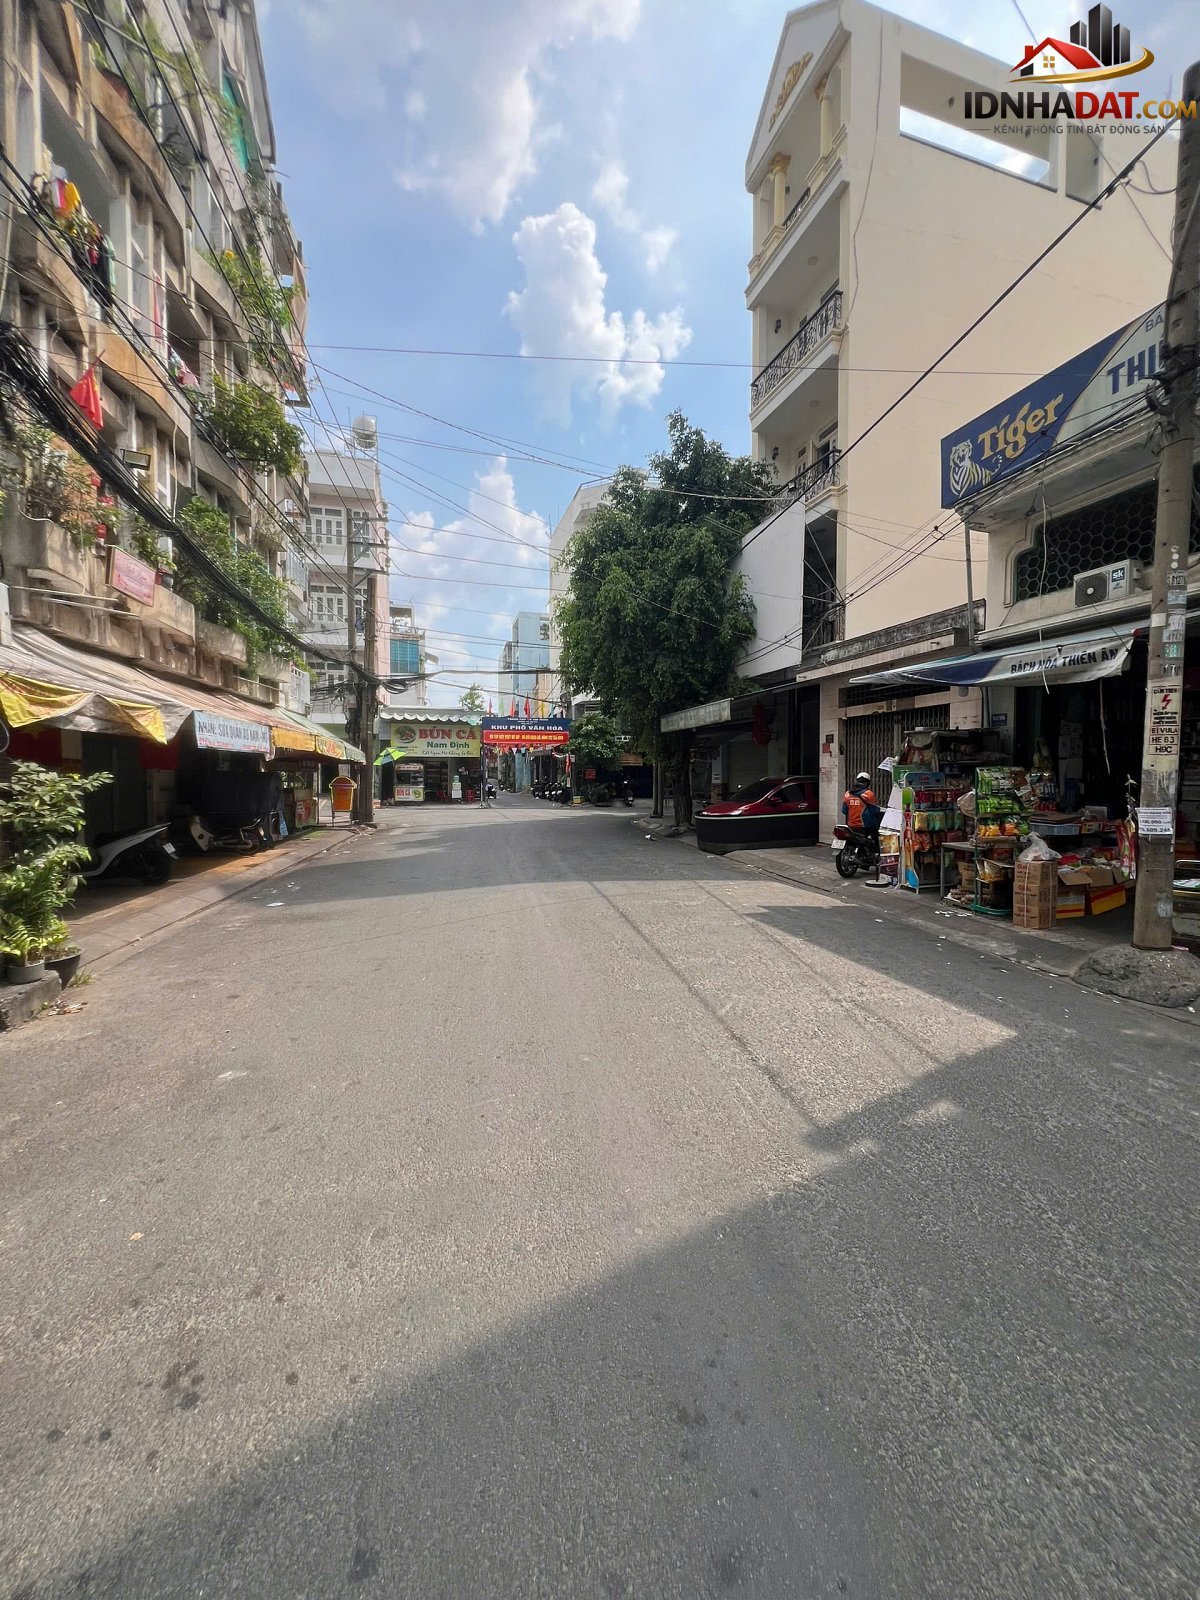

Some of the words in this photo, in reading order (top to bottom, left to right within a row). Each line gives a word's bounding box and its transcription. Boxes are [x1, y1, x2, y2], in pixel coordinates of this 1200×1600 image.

[976, 392, 1064, 460] Tiger
[1010, 661, 1037, 675] BÁCH
[1037, 656, 1058, 672] HÓA
[1061, 650, 1098, 667] THIÊN
[418, 726, 452, 740] BÚN
[456, 727, 477, 740] CÁ
[450, 741, 470, 750] Định
